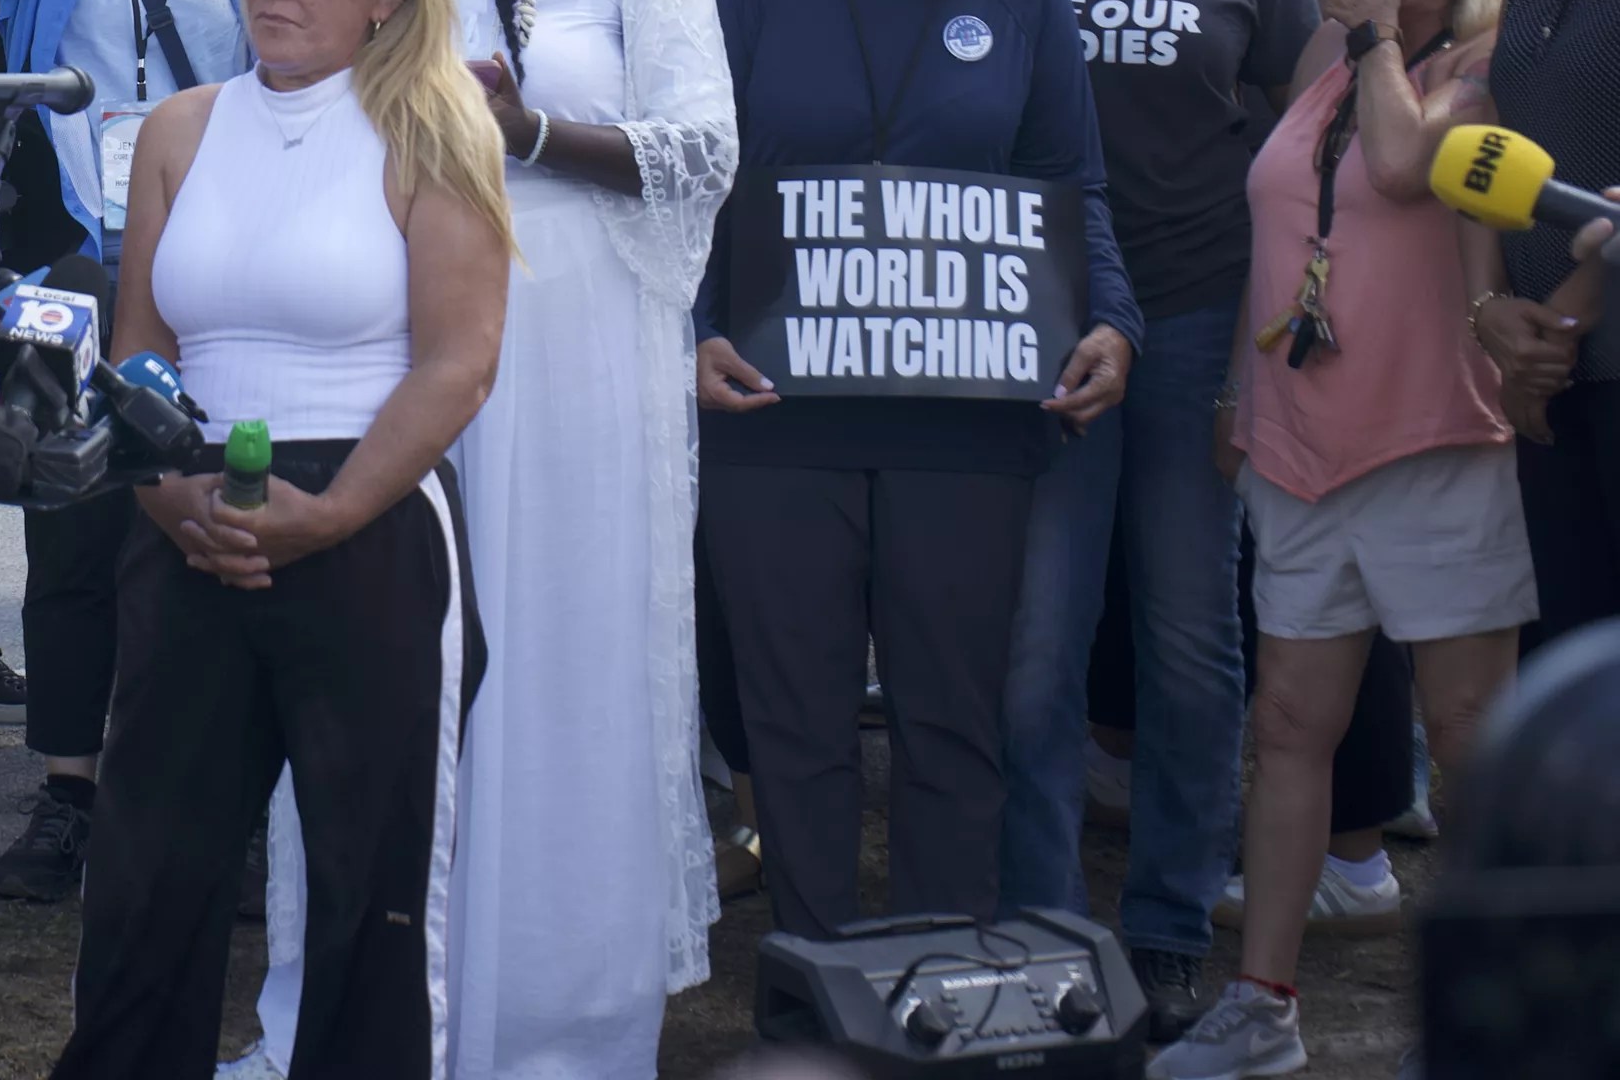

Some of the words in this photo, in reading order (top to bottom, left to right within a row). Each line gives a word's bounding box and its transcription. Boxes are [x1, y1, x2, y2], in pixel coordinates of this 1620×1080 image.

[1091, 0, 1202, 34] OUR
[1079, 30, 1180, 67] DIES
[1464, 131, 1511, 194] BNR
[777, 179, 865, 238] THE
[880, 180, 1045, 250] WHOLE
[33, 289, 76, 302] Local
[795, 248, 967, 308] WORLD
[983, 253, 1029, 313] IS
[9, 327, 64, 344] NEWS
[17, 300, 74, 334] 10
[785, 317, 1039, 382] WATCHING
